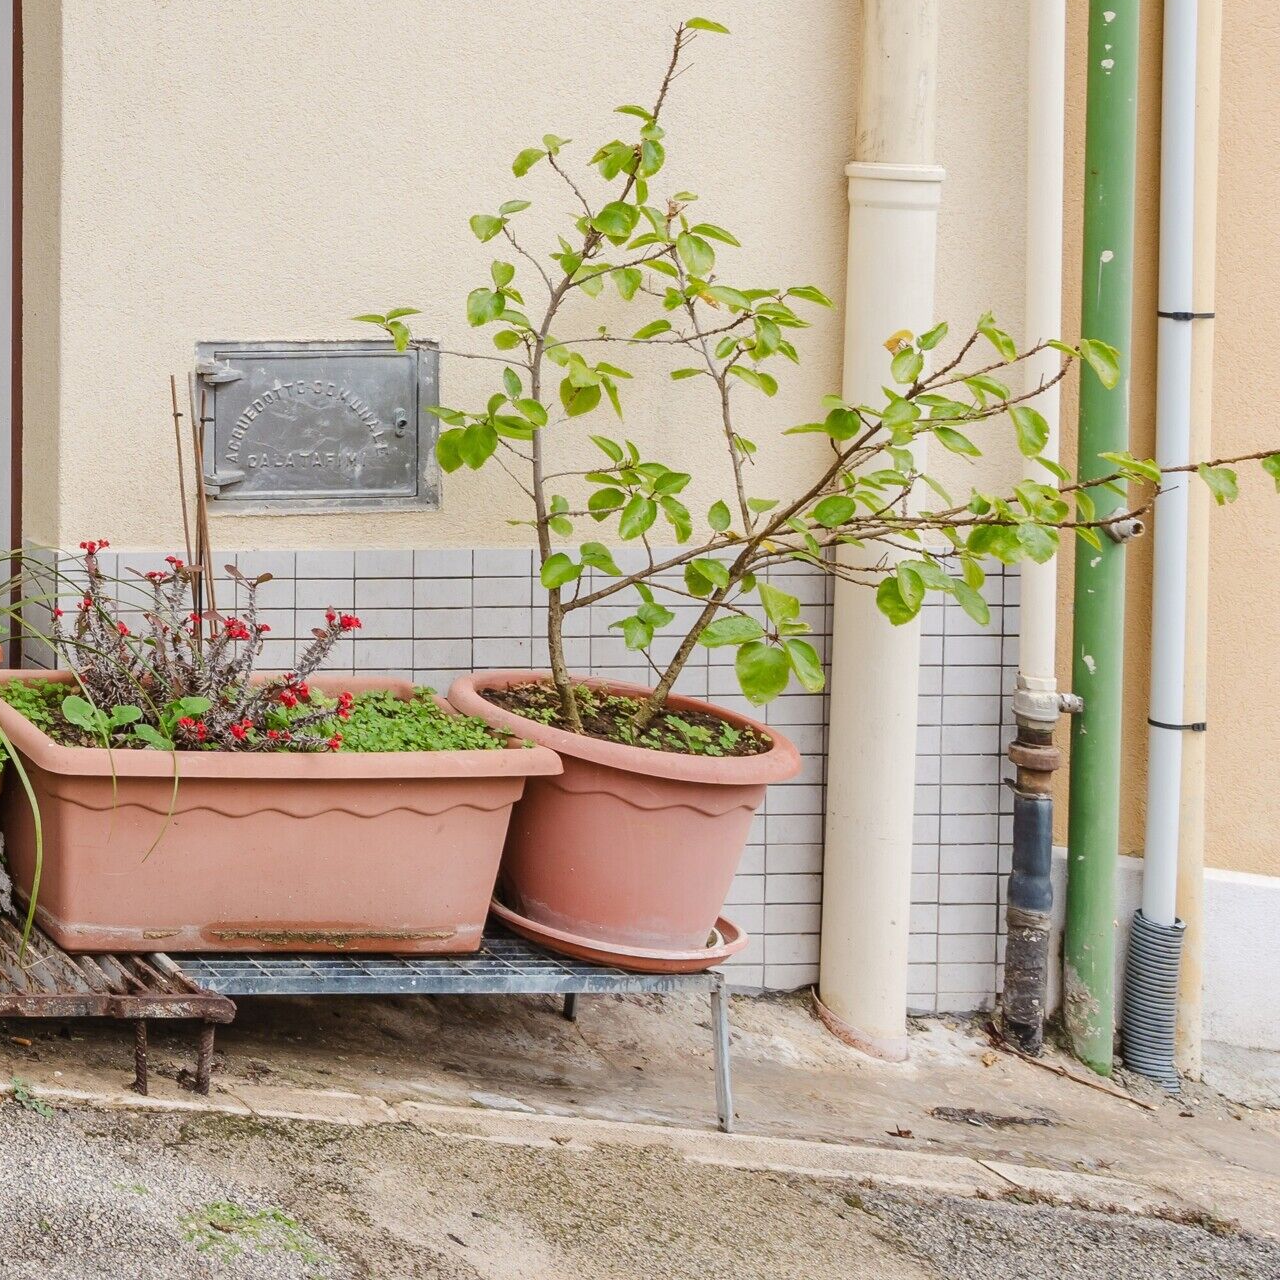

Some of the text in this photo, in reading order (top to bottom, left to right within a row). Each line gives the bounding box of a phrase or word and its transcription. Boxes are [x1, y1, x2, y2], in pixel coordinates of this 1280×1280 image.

[225, 379, 390, 464] ACQUEDOTTO COMUNALE
[247, 452, 368, 470] CALATAFIMI
